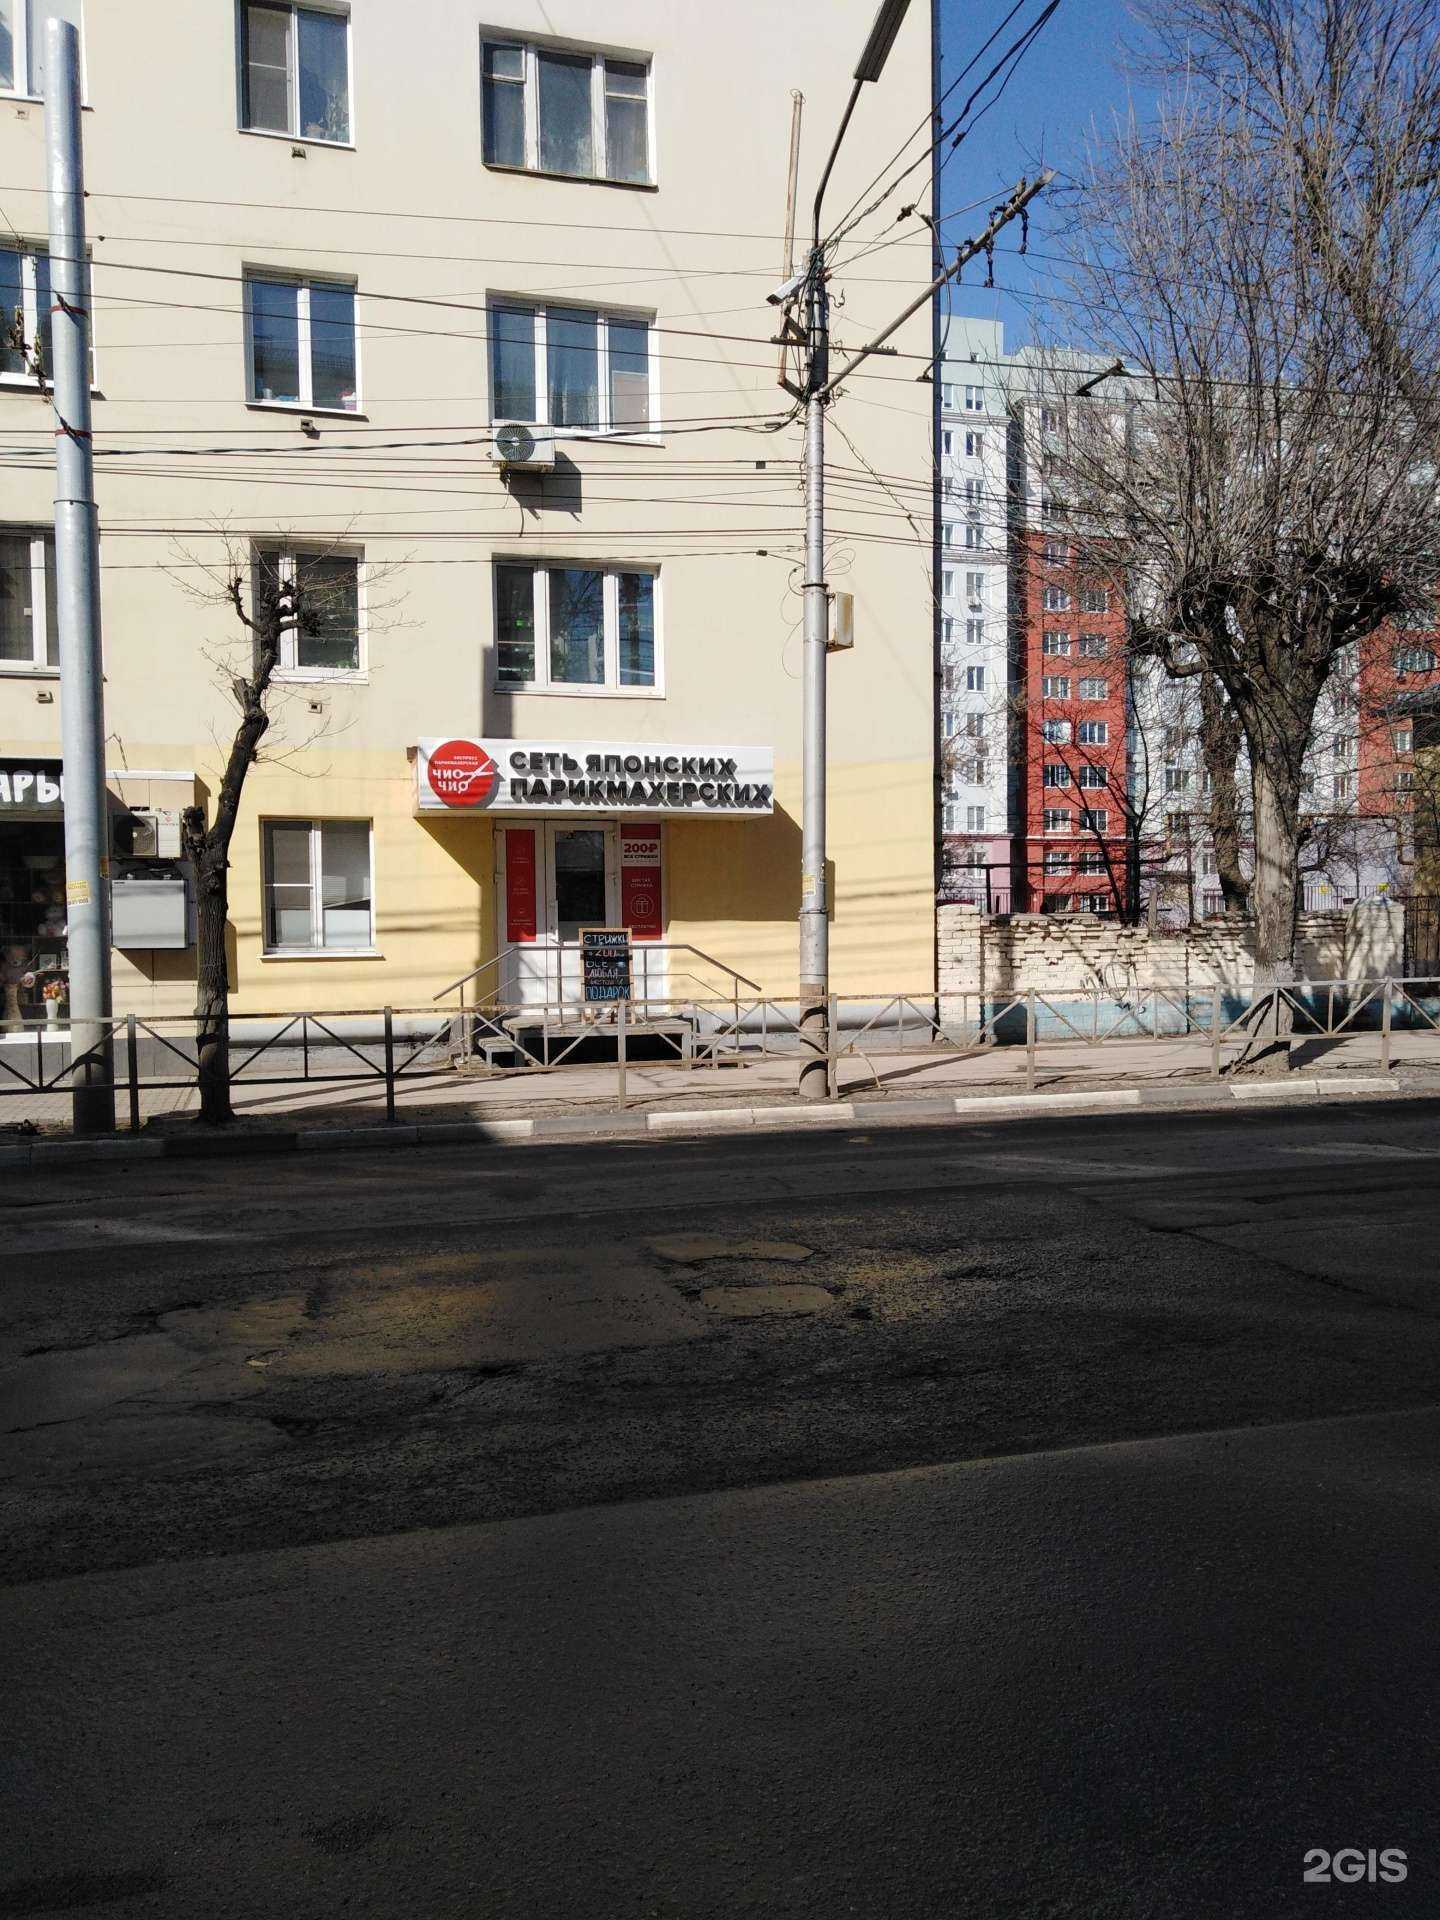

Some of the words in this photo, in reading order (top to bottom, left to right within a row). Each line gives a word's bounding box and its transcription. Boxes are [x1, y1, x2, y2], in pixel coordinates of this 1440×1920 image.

[509, 751, 580, 773] СЕТЬ
[585, 754, 736, 777] ЯПОНСКИХ
[432, 769, 464, 779] ЧИО
[438, 781, 469, 792] ЧИО
[510, 778, 771, 805] ПАРИКМАХЕРСКИХ
